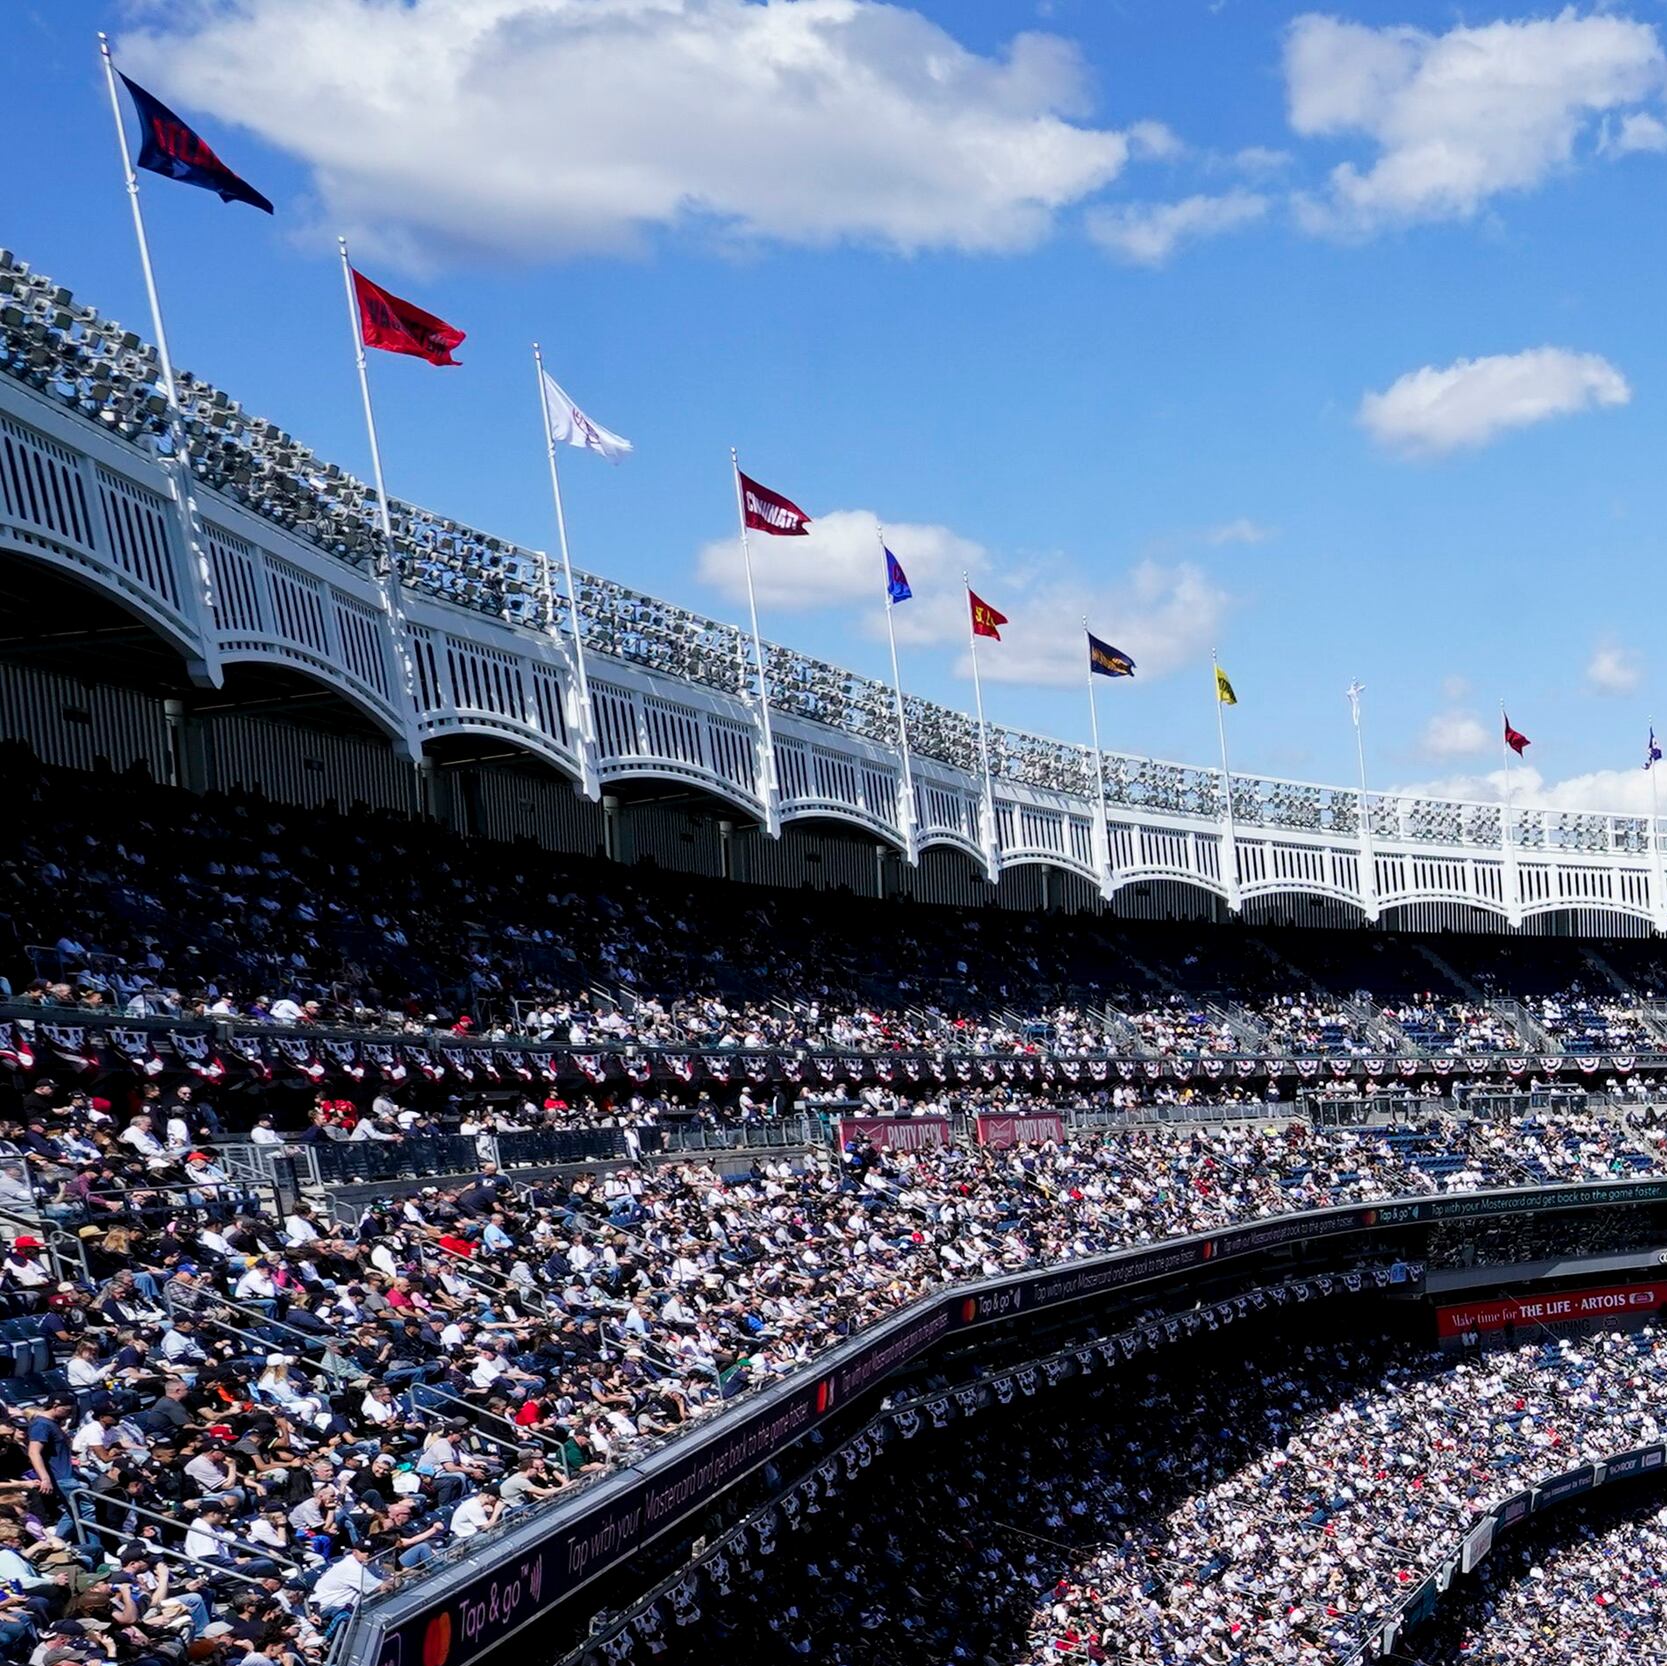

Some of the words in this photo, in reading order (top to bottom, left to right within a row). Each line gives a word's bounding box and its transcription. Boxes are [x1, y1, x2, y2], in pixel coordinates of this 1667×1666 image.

[1477, 1310, 1501, 1325] time
[1503, 1308, 1518, 1321] for
[1519, 1304, 1544, 1318] THE
[1546, 1300, 1572, 1315] LIFE
[1580, 1294, 1626, 1310] ARTOIS
[567, 1535, 588, 1575] Tap
[591, 1513, 616, 1556] with
[615, 1505, 642, 1552] your
[643, 1463, 697, 1528] Mastercard
